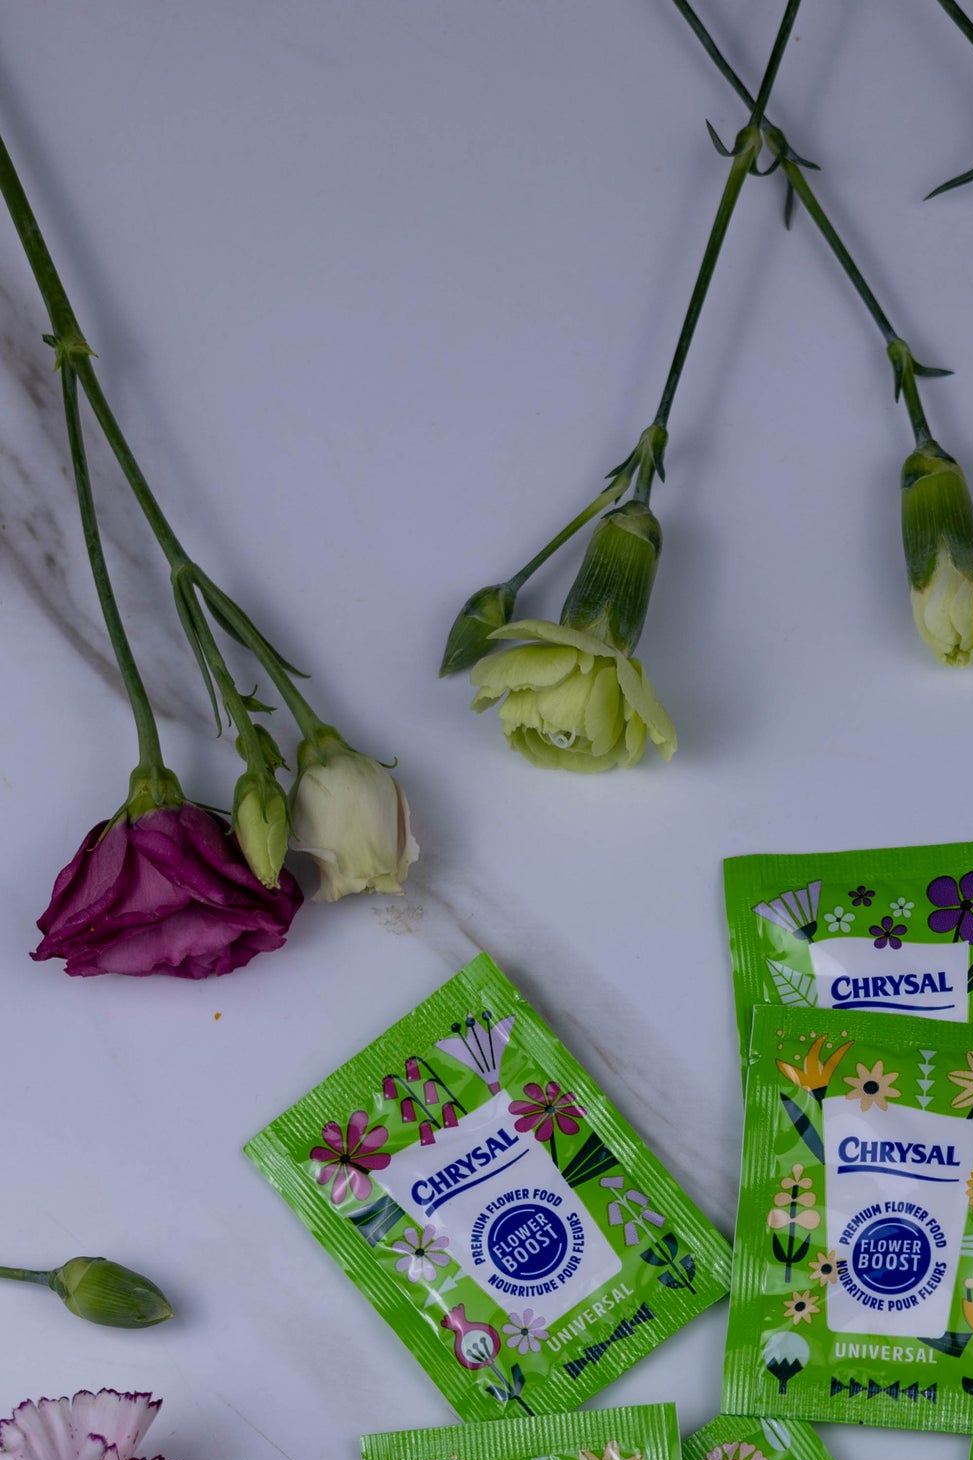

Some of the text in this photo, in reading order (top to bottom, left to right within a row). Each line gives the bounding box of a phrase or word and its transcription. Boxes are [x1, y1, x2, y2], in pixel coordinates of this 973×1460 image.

[831, 971, 953, 1000] CHRYSAL
[411, 1128, 519, 1206] CHRYSAL
[838, 1136, 960, 1166] CHRYSAL
[471, 1189, 562, 1265] PREMIUM FLOWER FOOD
[493, 1213, 549, 1258] FLOWER
[839, 1202, 946, 1248] PREMIUM FLOWER FOOD
[860, 1240, 921, 1253] FLOWER
[488, 1212, 584, 1297] NOURRITURE POUR FLEURS
[501, 1225, 559, 1273] BOOST
[858, 1254, 921, 1271] BOOST
[836, 1260, 947, 1312] NOURRITURE POUR FLEURS
[547, 1283, 634, 1352] UNIVERSAL
[835, 1343, 937, 1364] UNIVERSAL
